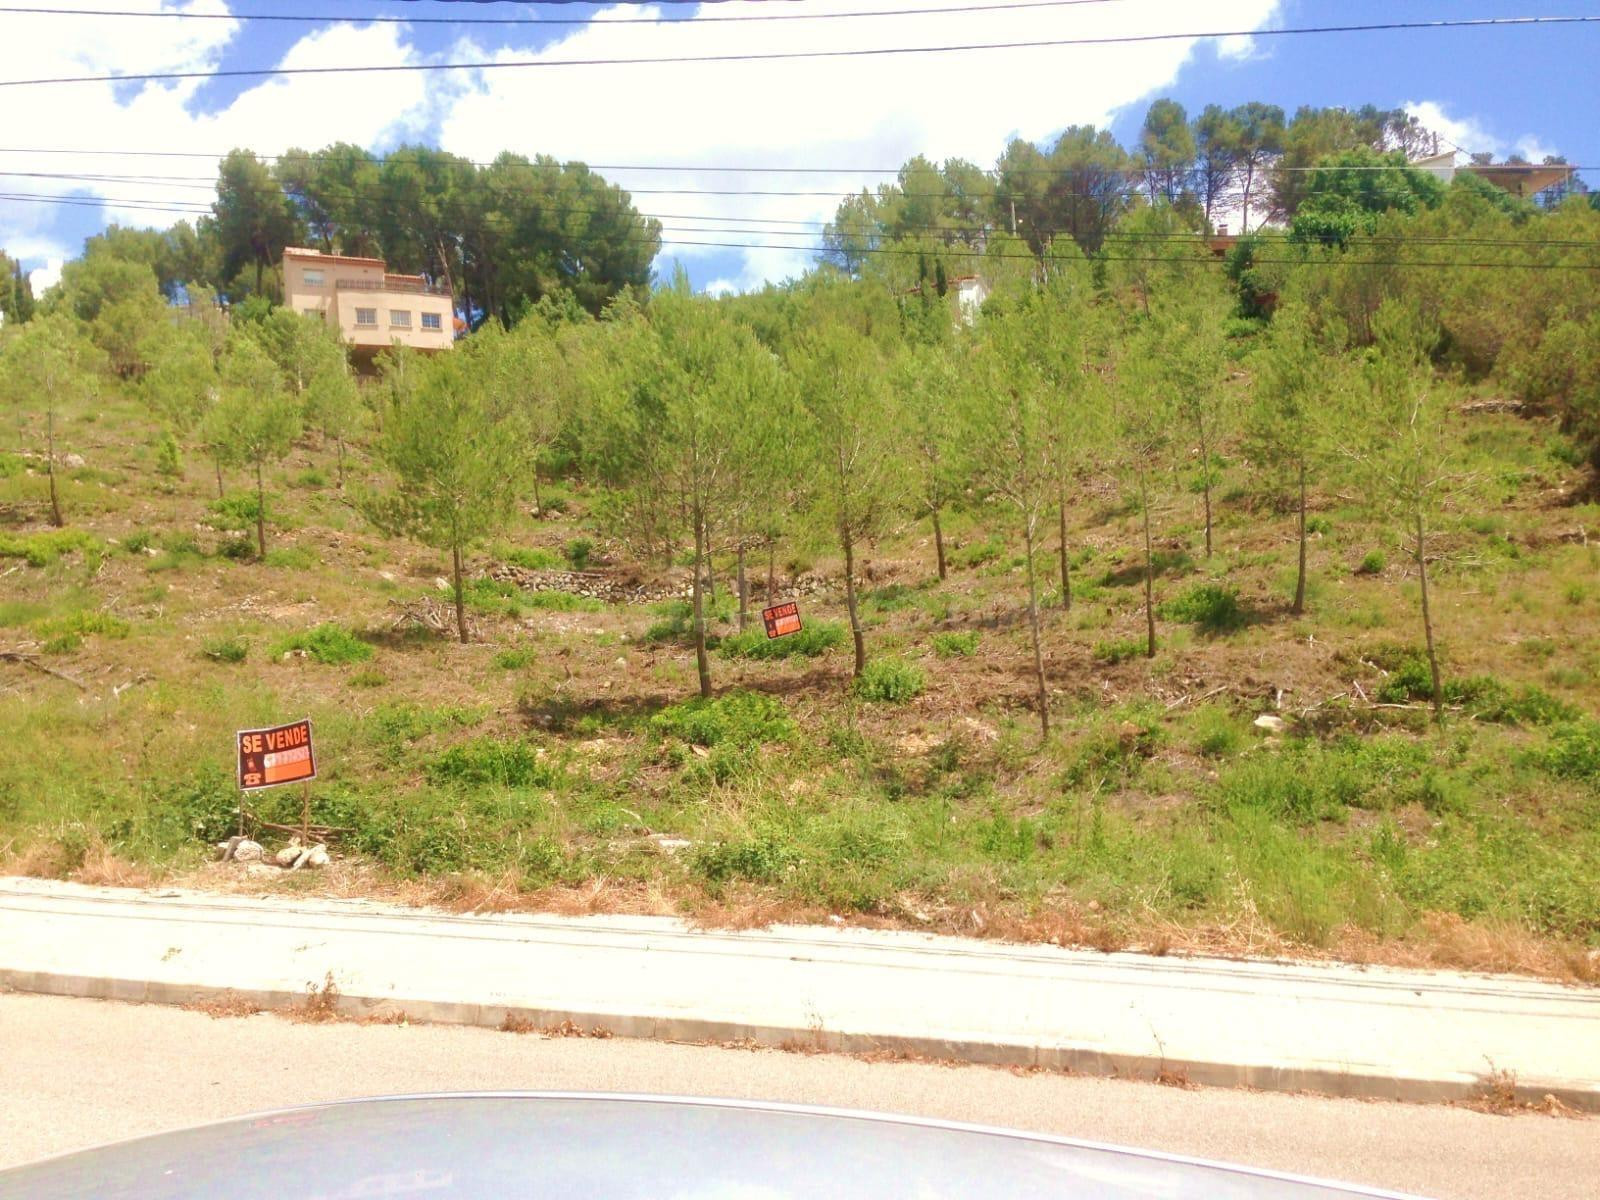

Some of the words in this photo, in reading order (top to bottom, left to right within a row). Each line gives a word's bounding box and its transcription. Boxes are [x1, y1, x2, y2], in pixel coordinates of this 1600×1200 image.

[773, 603, 797, 619] VENDE
[242, 734, 262, 754] SE
[265, 725, 308, 750] VENDE
